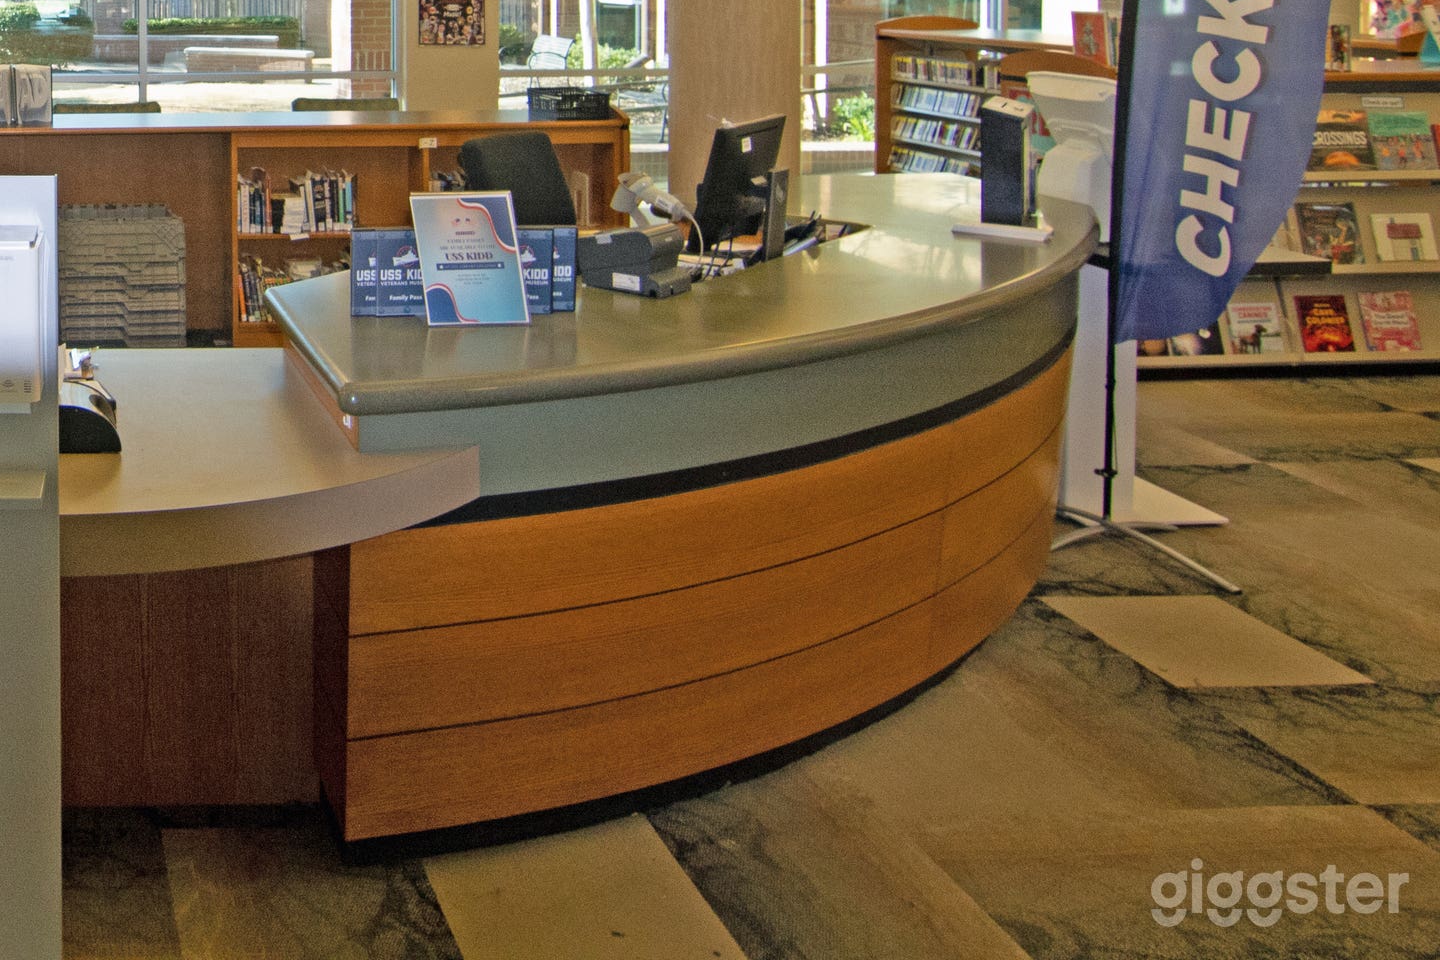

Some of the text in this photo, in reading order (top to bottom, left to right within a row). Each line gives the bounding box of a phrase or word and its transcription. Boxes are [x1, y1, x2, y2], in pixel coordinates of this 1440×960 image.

[445, 251, 494, 261] USS KIDD
[380, 269, 402, 281] USS
[523, 268, 549, 280] KIDD
[389, 294, 409, 302] Family
